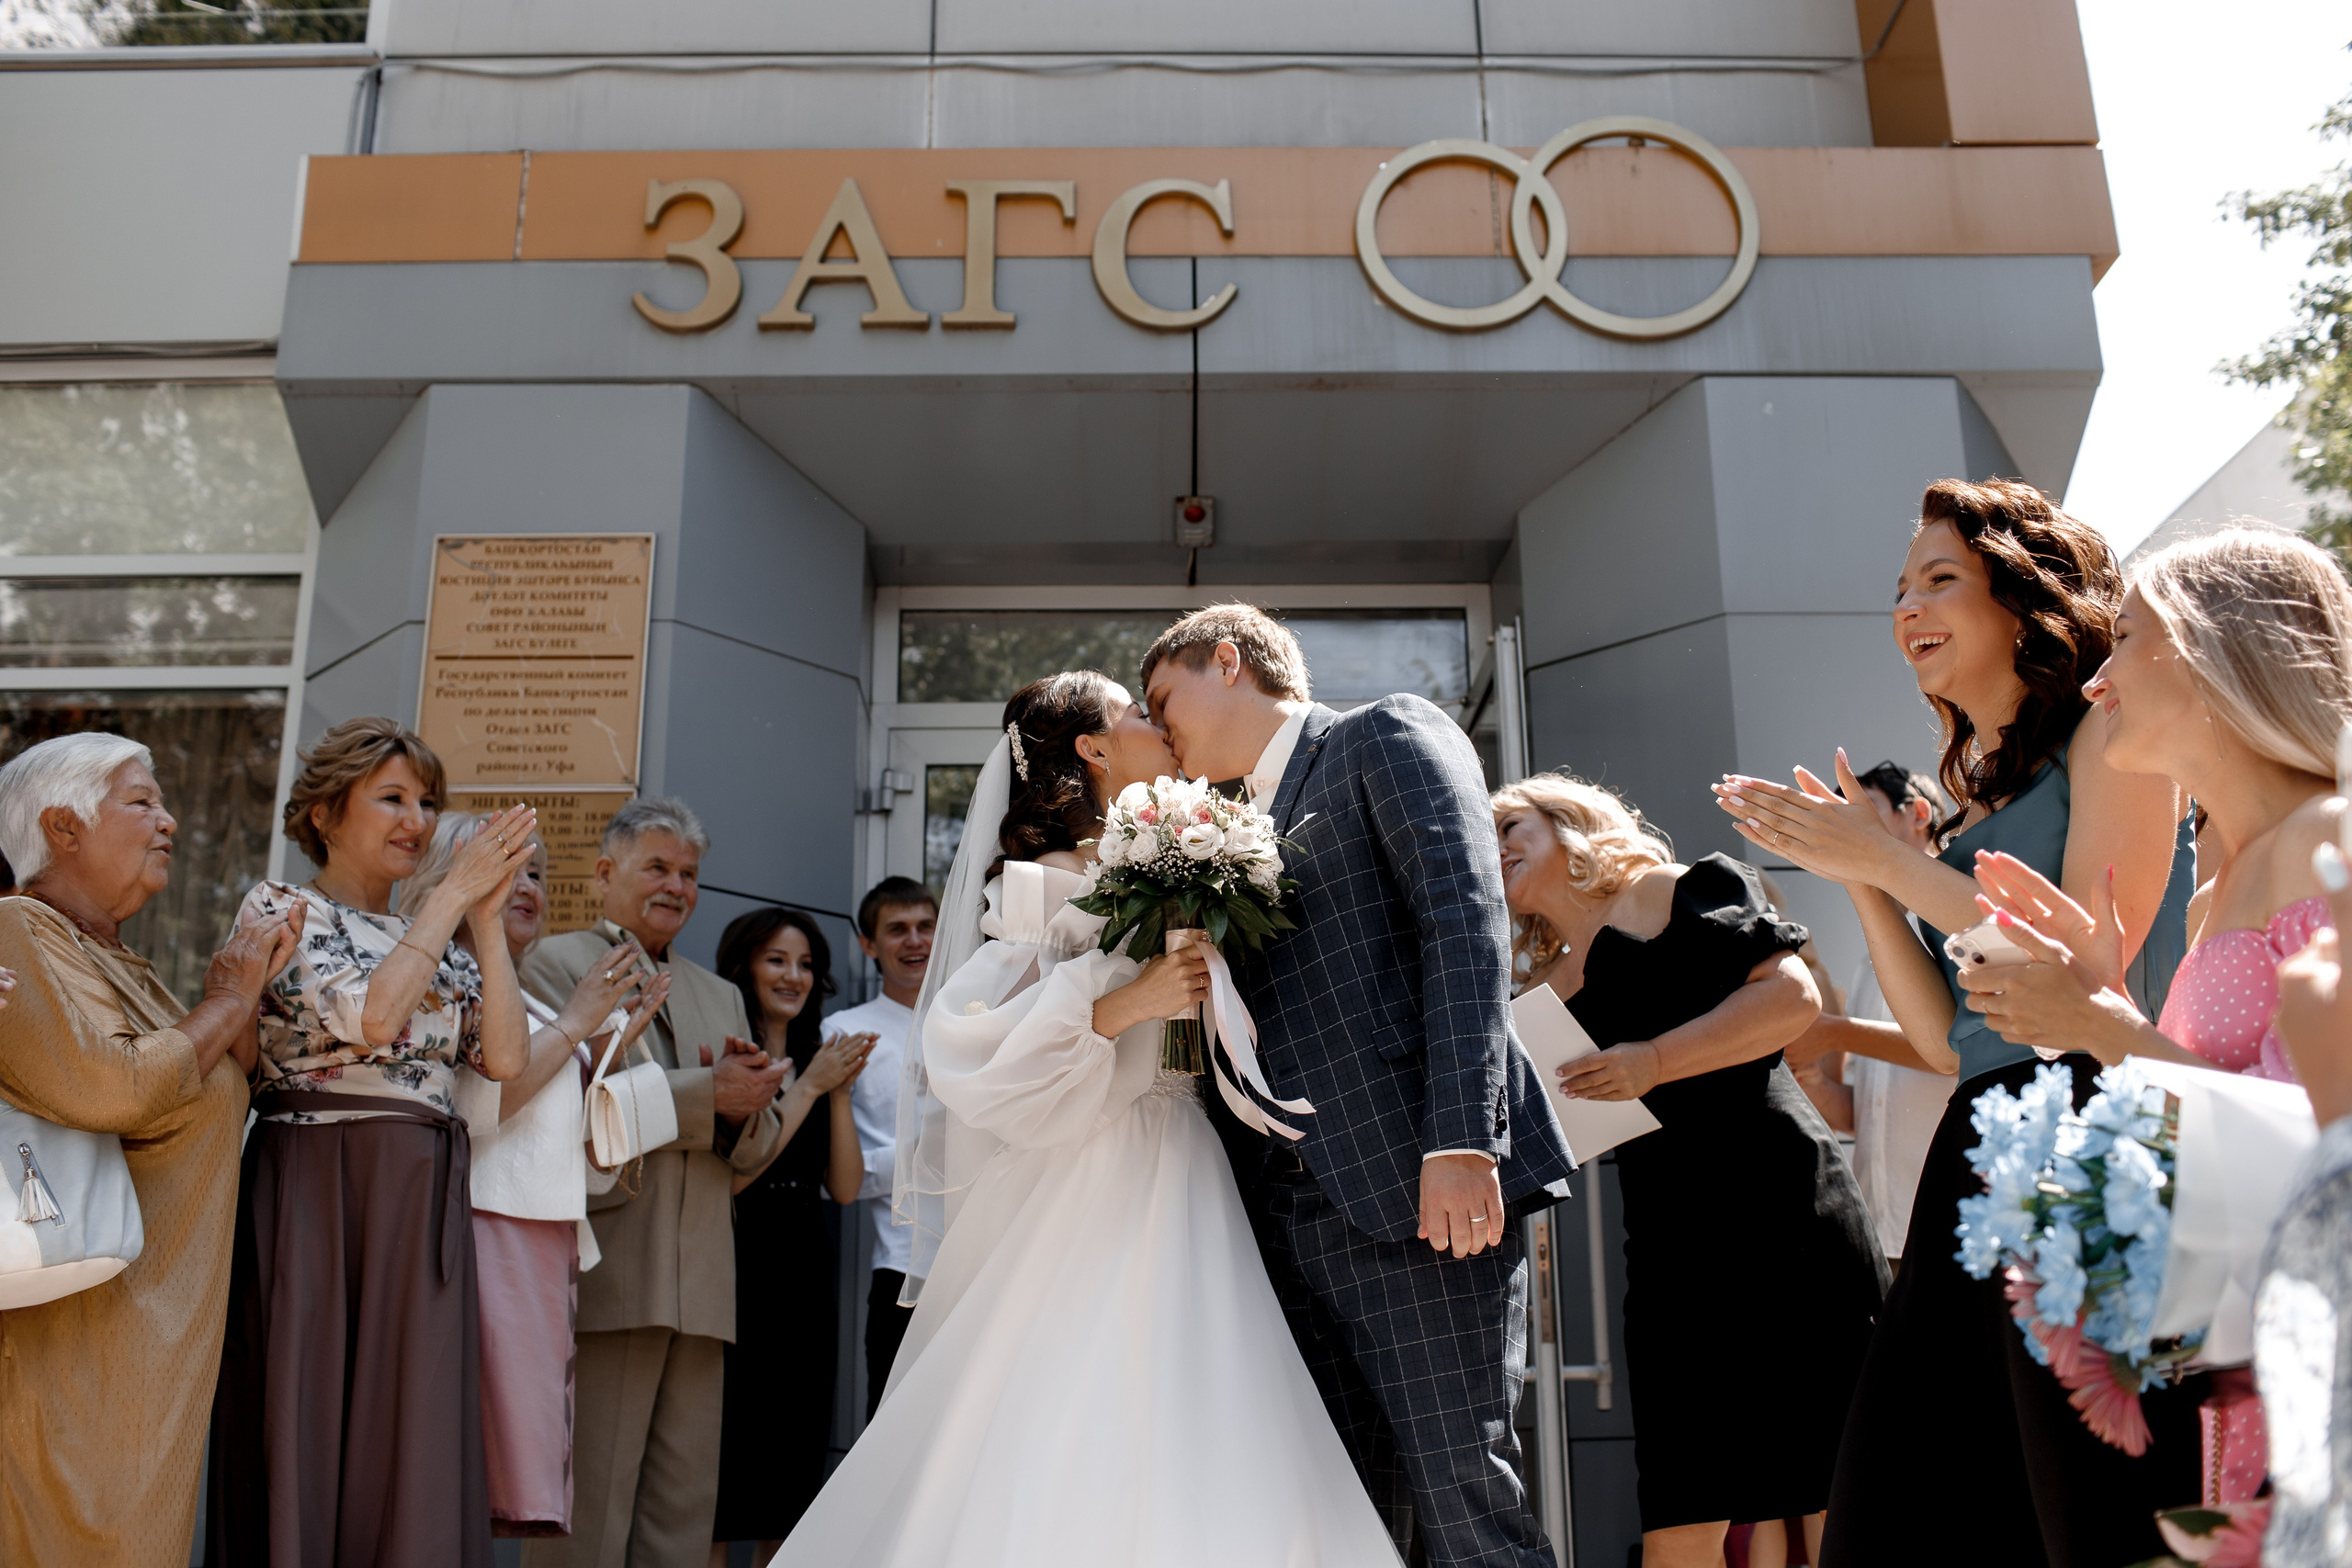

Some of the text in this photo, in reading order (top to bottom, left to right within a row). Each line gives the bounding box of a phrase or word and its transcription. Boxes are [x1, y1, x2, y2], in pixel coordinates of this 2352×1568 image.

[631, 177, 1238, 333] ЗАГС
[567, 670, 628, 681] комитет
[534, 721, 572, 735] ЗАГС
